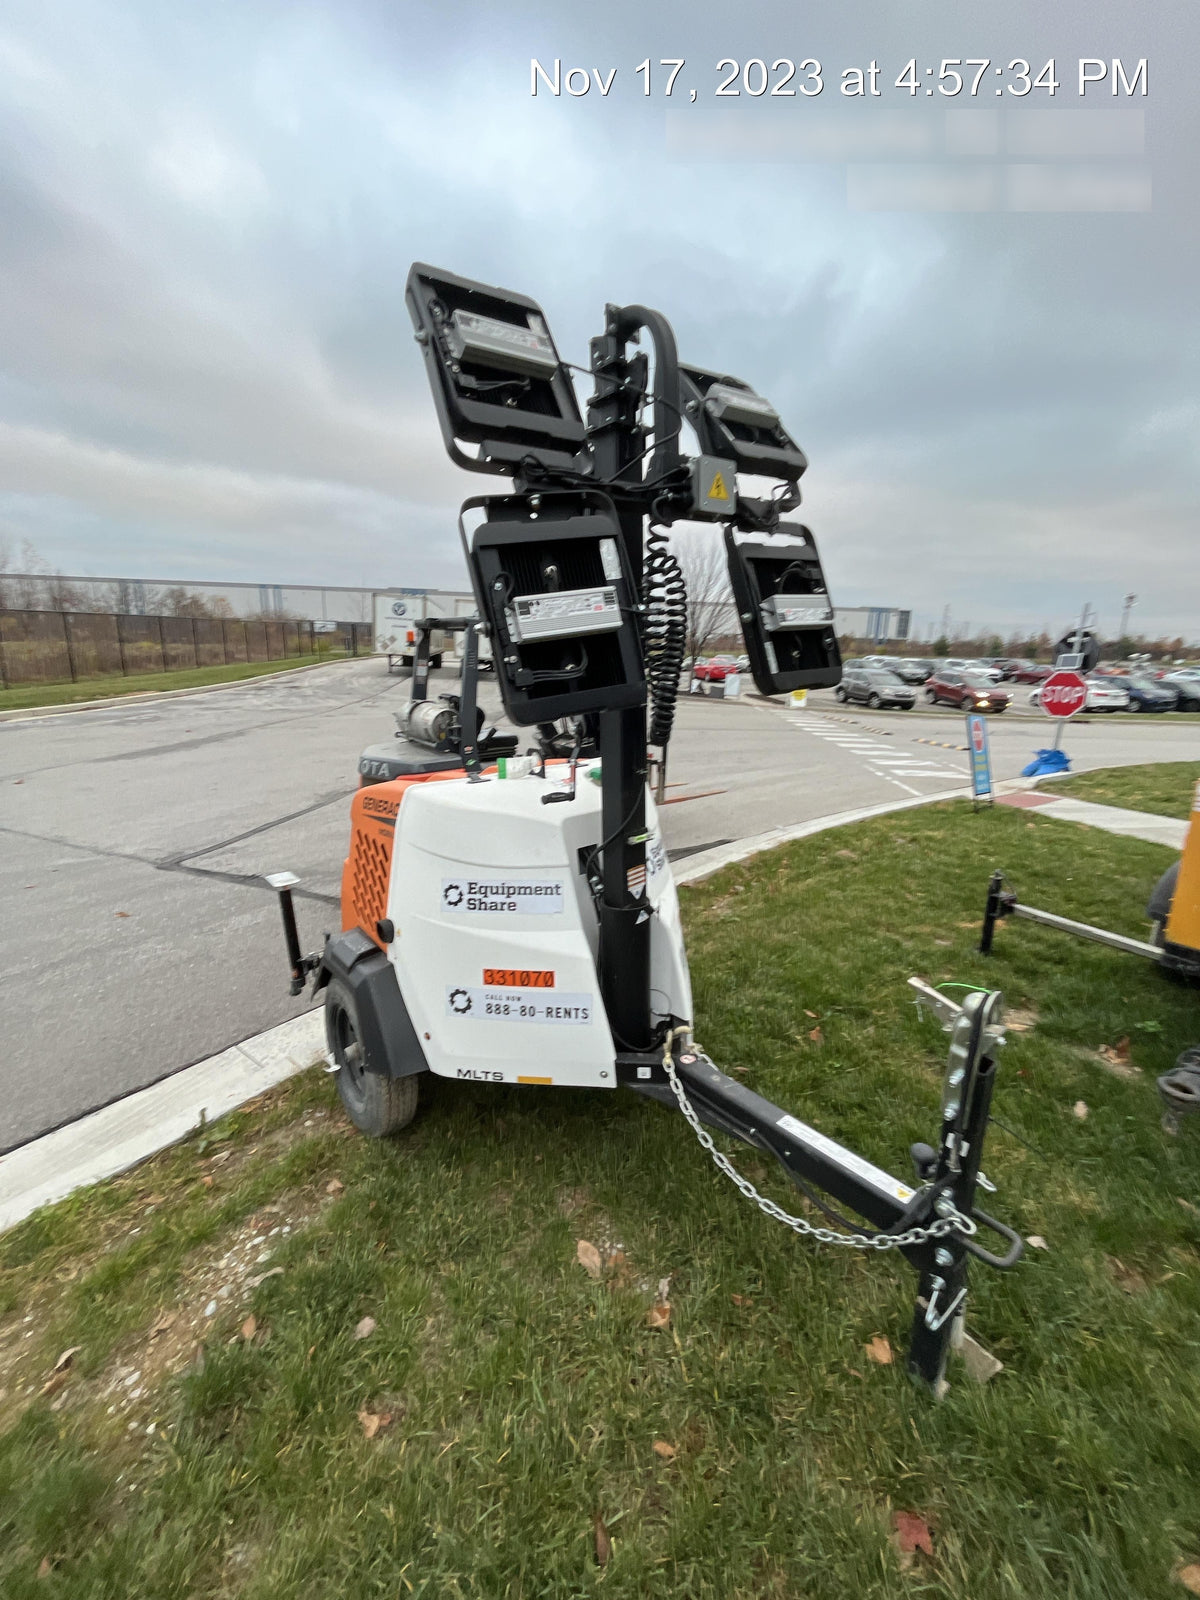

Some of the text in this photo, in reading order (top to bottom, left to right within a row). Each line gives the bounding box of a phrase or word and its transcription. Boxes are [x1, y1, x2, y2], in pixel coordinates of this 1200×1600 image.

[1042, 685, 1086, 704] STOP
[467, 881, 562, 898] Equipment
[467, 898, 517, 911] Share
[484, 969, 554, 987] 331070
[485, 1003, 589, 1020] 888-80-RENTS
[457, 1068, 504, 1081] MLTS
